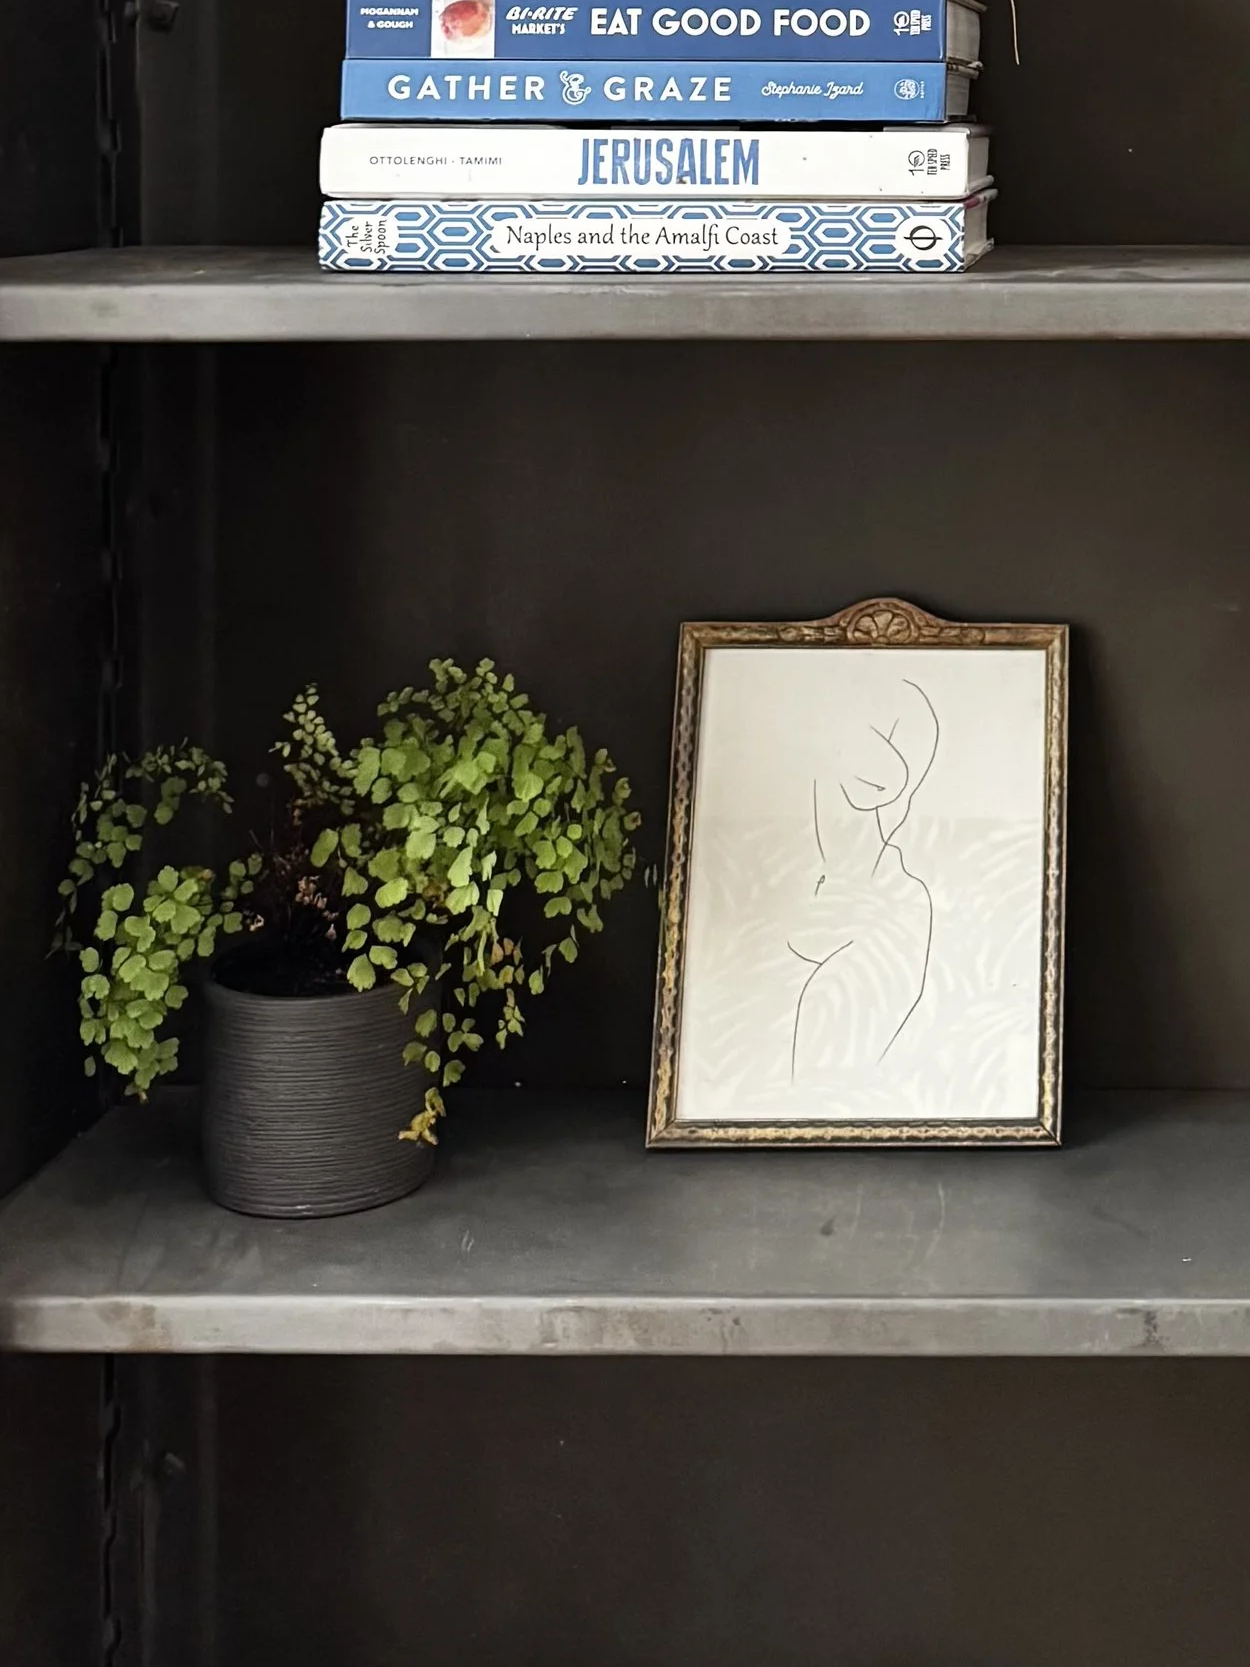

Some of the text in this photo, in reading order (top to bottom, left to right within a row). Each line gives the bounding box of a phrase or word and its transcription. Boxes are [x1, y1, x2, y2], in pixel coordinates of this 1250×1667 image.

[360, 7, 419, 16] MOGANNAM
[376, 20, 414, 29] GOUGH
[590, 7, 871, 38] EAT GOOD FOOD
[387, 70, 732, 106] GATHER & GRAZE
[761, 81, 865, 99] Stephanie Izard
[369, 156, 503, 166] OTTOLENGHI TAMIMI
[577, 137, 760, 186] JERUSALEM
[347, 225, 360, 248] The
[360, 221, 373, 253] Silver
[373, 219, 388, 255] Spoon
[506, 223, 780, 252] Naples and the Amalfi Coast
